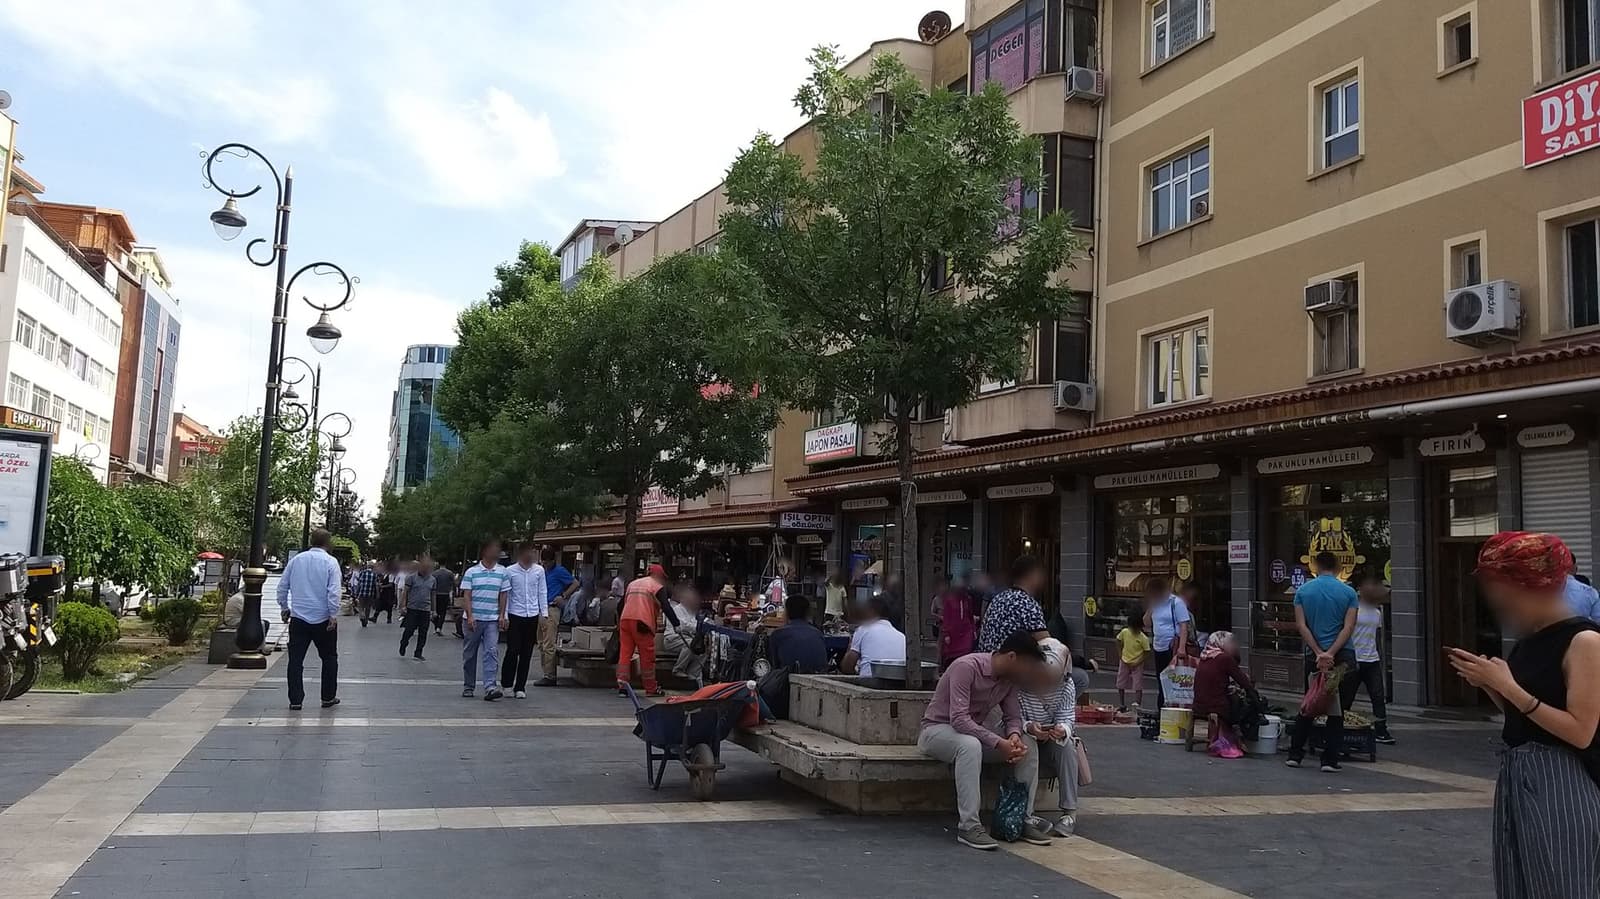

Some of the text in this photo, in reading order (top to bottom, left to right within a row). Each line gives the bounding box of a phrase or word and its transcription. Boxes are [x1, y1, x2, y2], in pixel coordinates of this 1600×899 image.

[1541, 81, 1600, 135] DiY
[1545, 121, 1600, 154] SAT
[1487, 285, 1496, 315] arçelik
[806, 432, 855, 453] JAPON PASAJI
[1433, 438, 1472, 452] FIRIN
[1268, 461, 1283, 471] PAK
[1285, 458, 1307, 469] UNLU
[1111, 476, 1126, 486] PAK
[1127, 473, 1148, 485] UNLU
[784, 513, 801, 522] IŞIL
[1319, 536, 1344, 551] PAK
